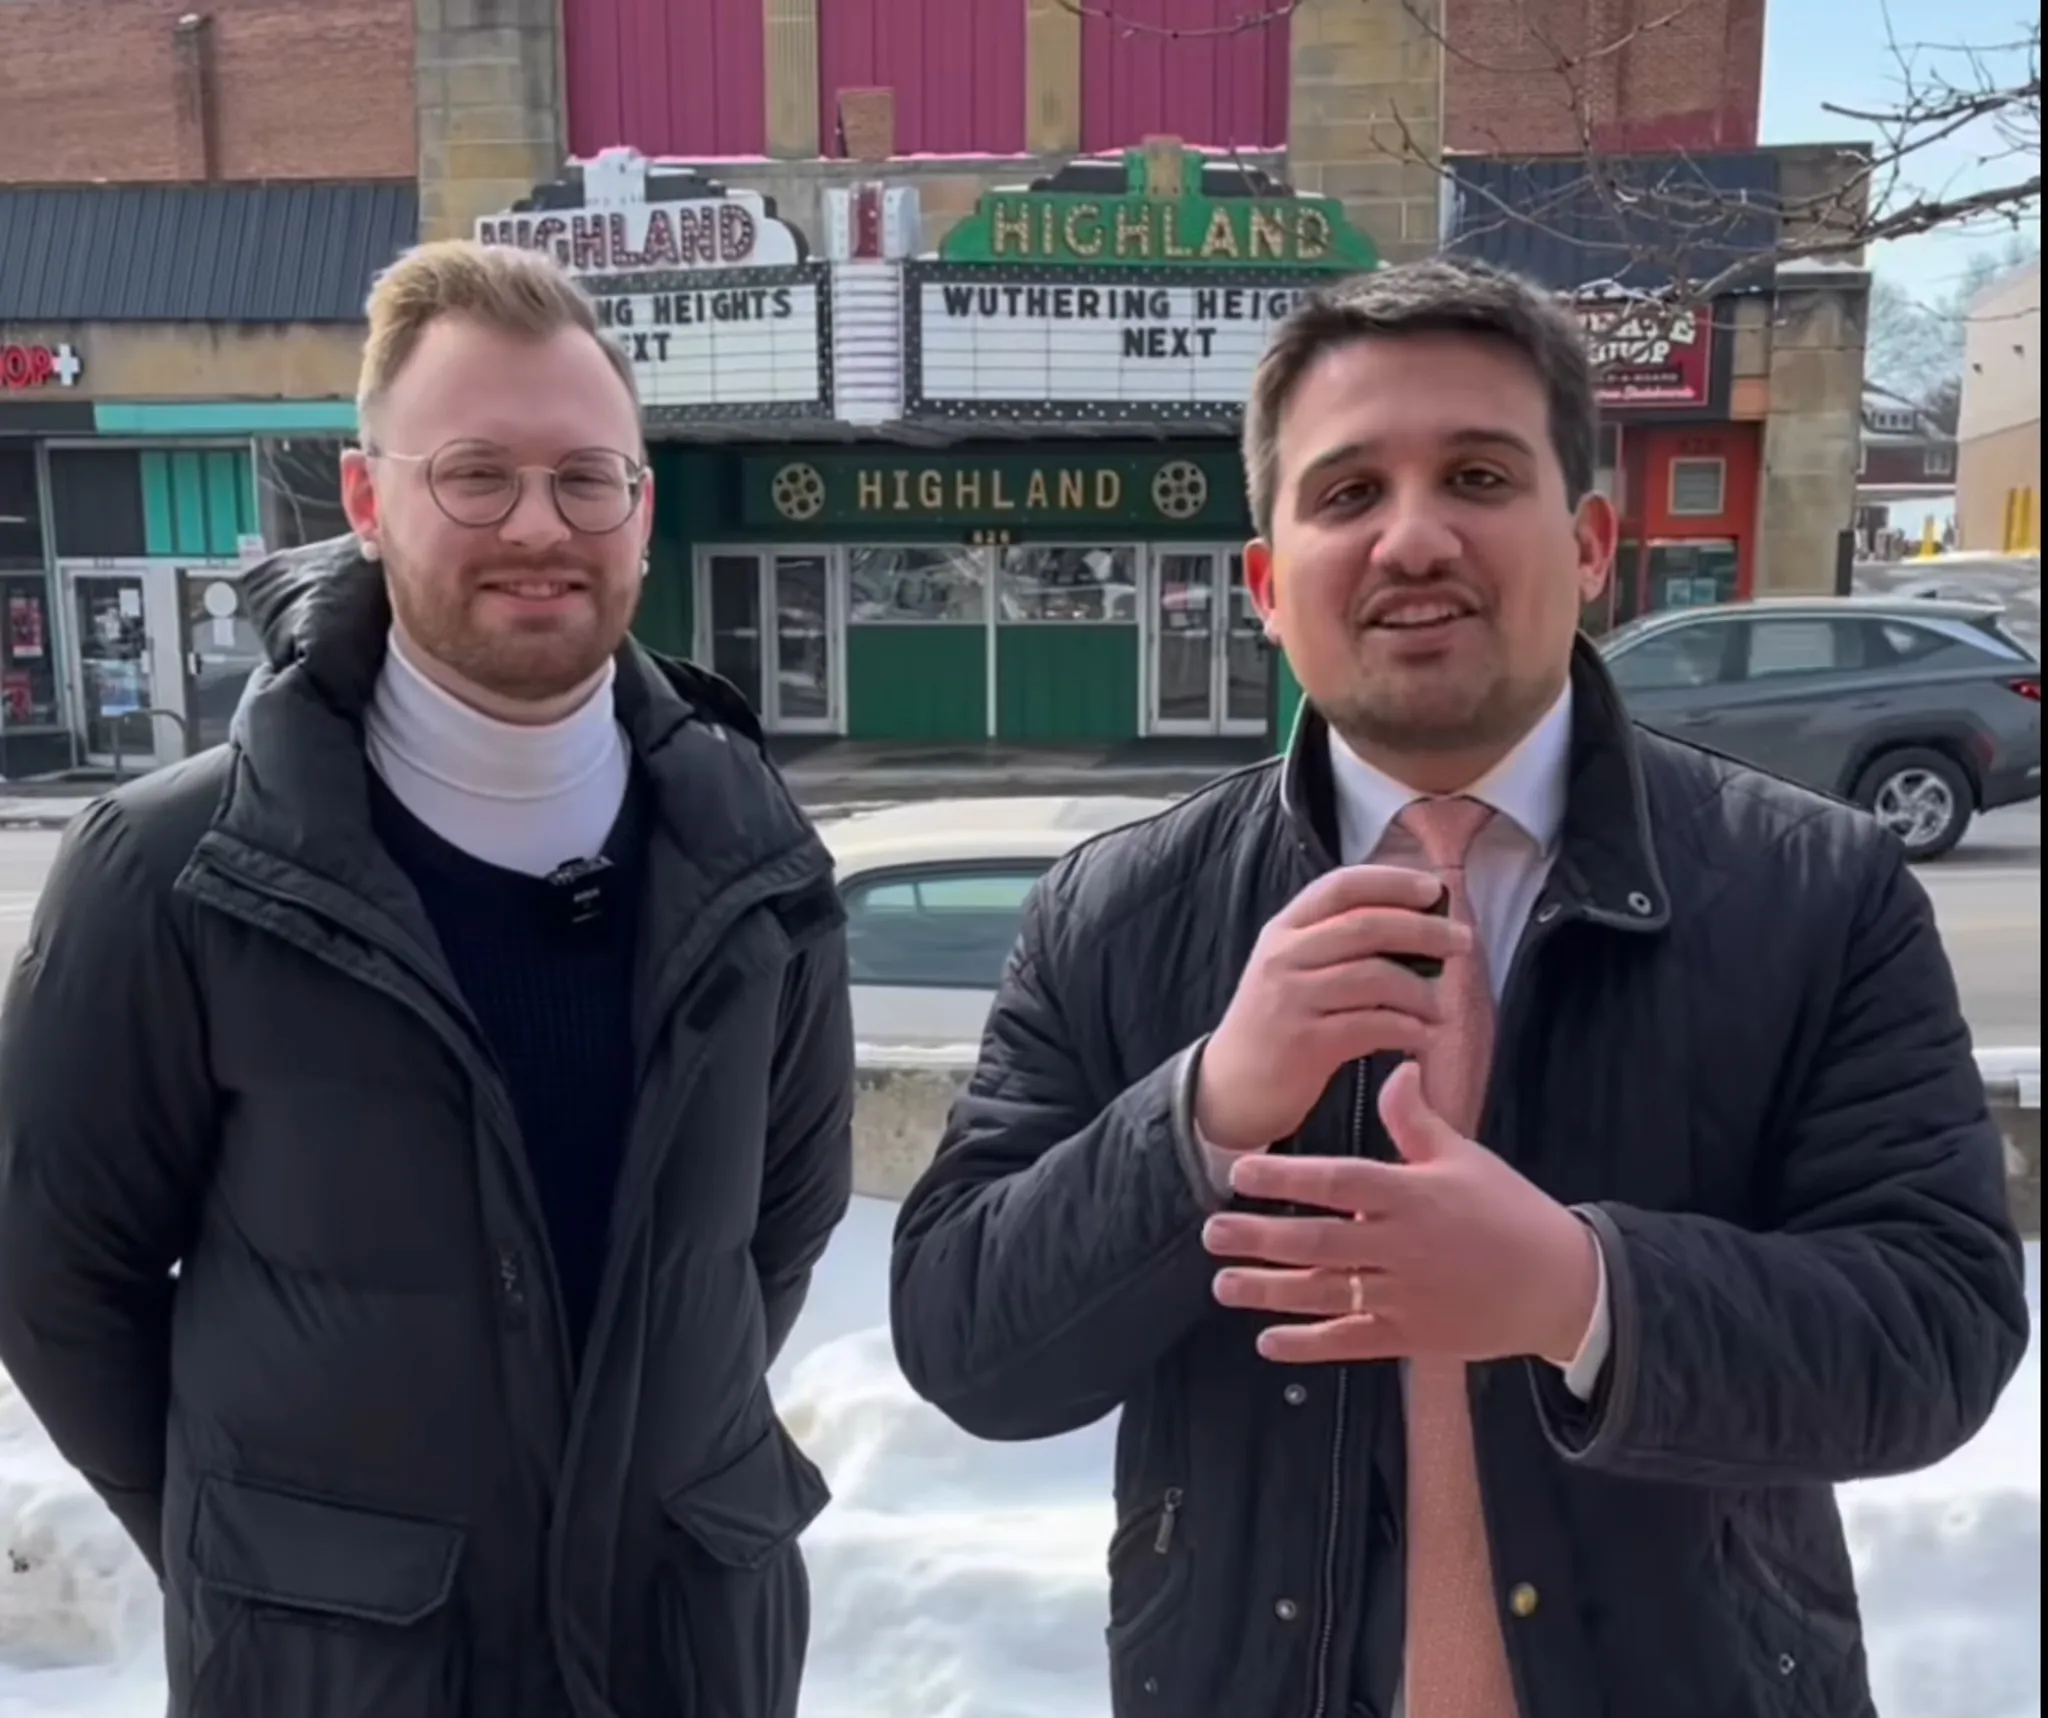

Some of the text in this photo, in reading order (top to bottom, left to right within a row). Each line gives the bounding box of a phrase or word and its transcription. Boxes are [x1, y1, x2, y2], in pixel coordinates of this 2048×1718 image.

[993, 202, 1331, 260] HIGHLAND
[654, 288, 793, 325] HEIGHTS
[942, 286, 1171, 320] WUTHERING
[1123, 327, 1217, 358] NEXT
[858, 469, 1121, 510] HIGHLAND
